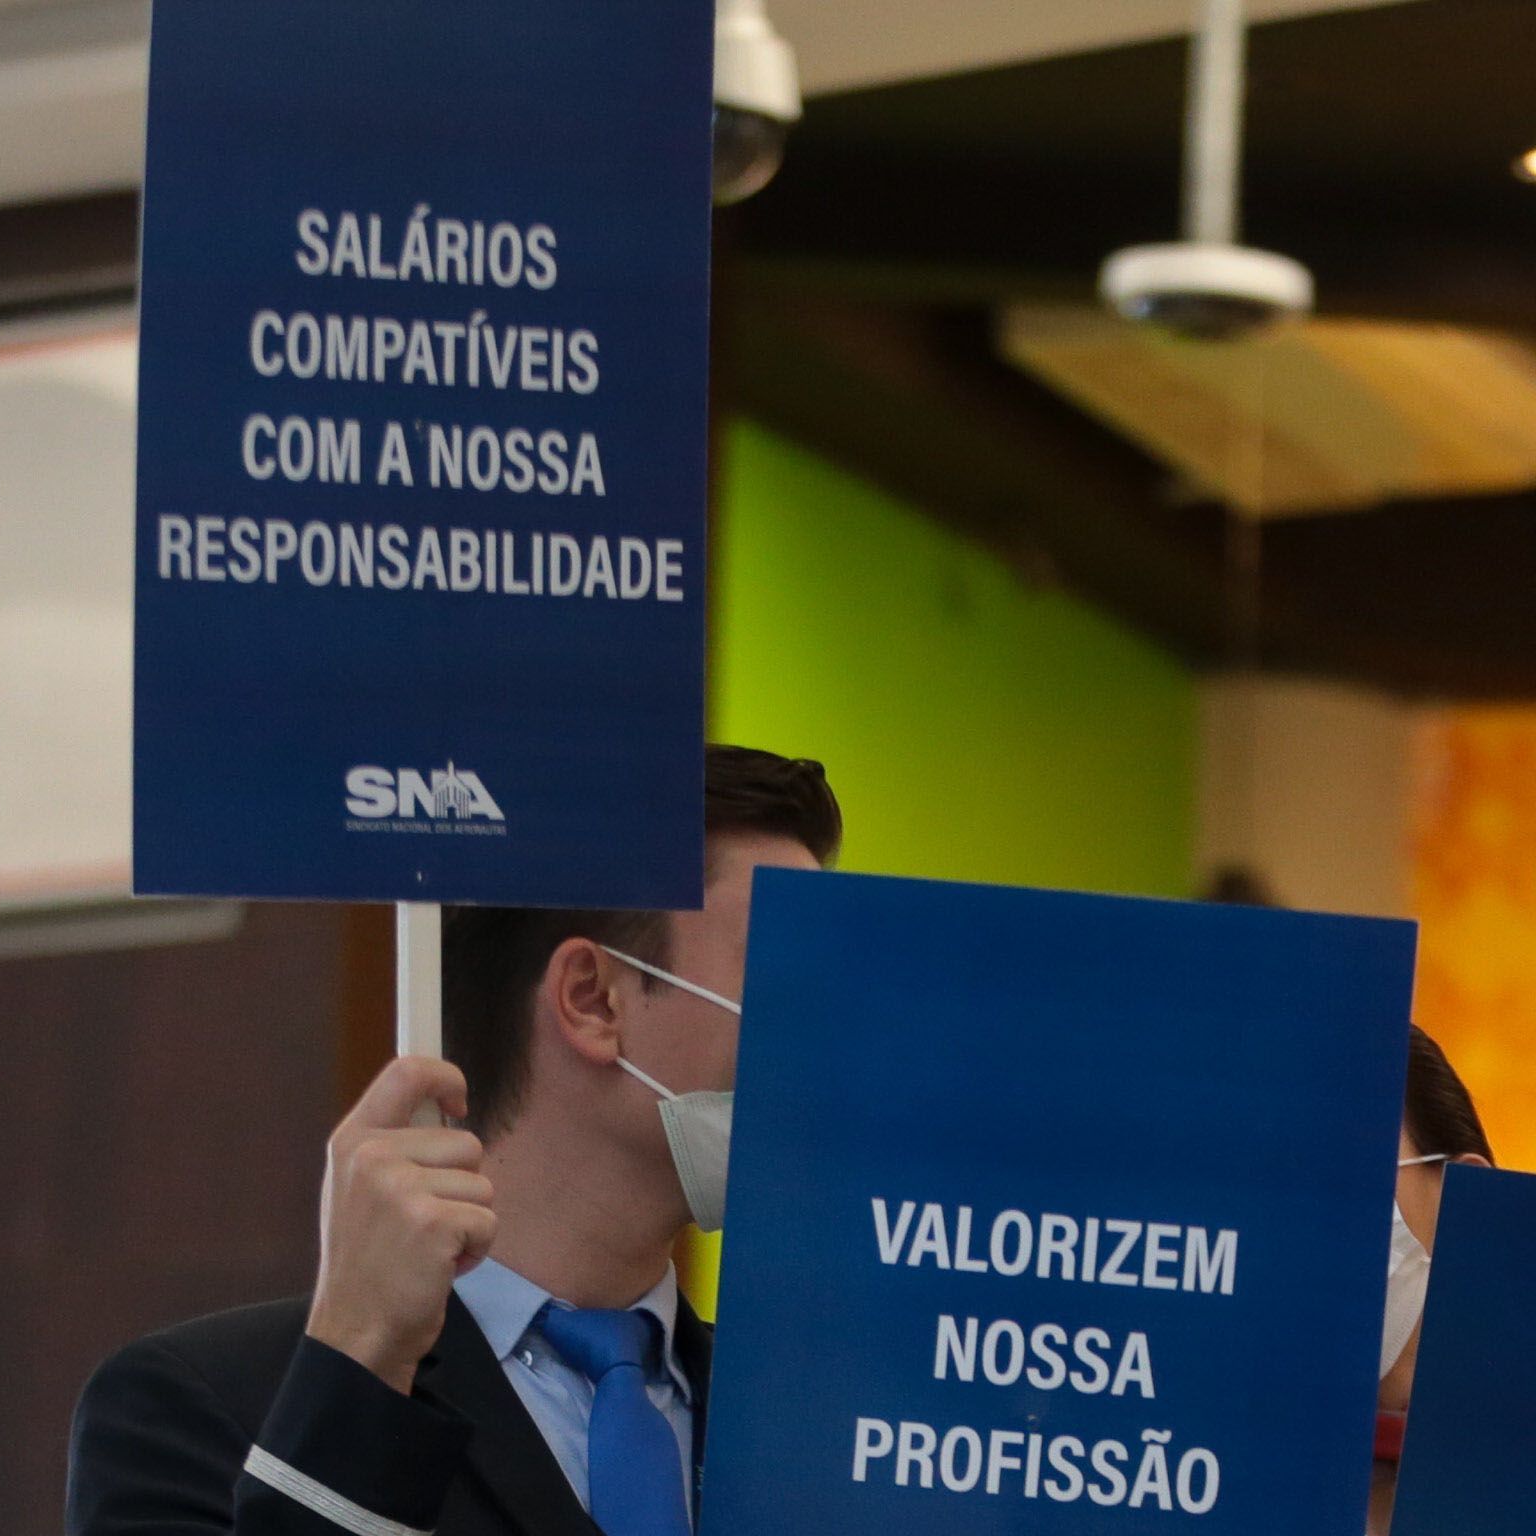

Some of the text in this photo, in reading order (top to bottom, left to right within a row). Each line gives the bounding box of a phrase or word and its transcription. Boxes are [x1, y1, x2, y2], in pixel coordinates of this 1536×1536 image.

[297, 204, 557, 289] SALÁRIOS
[250, 310, 599, 394] COMPATÍVEIS
[242, 415, 606, 496] COM A NOSSA
[159, 515, 684, 601] RESPONSABILIDADE
[346, 760, 506, 821] SNA
[871, 1198, 1238, 1295] VALORIZEM
[934, 1314, 1155, 1398] NOSSA
[852, 1417, 1220, 1514] PROFISSÃO
